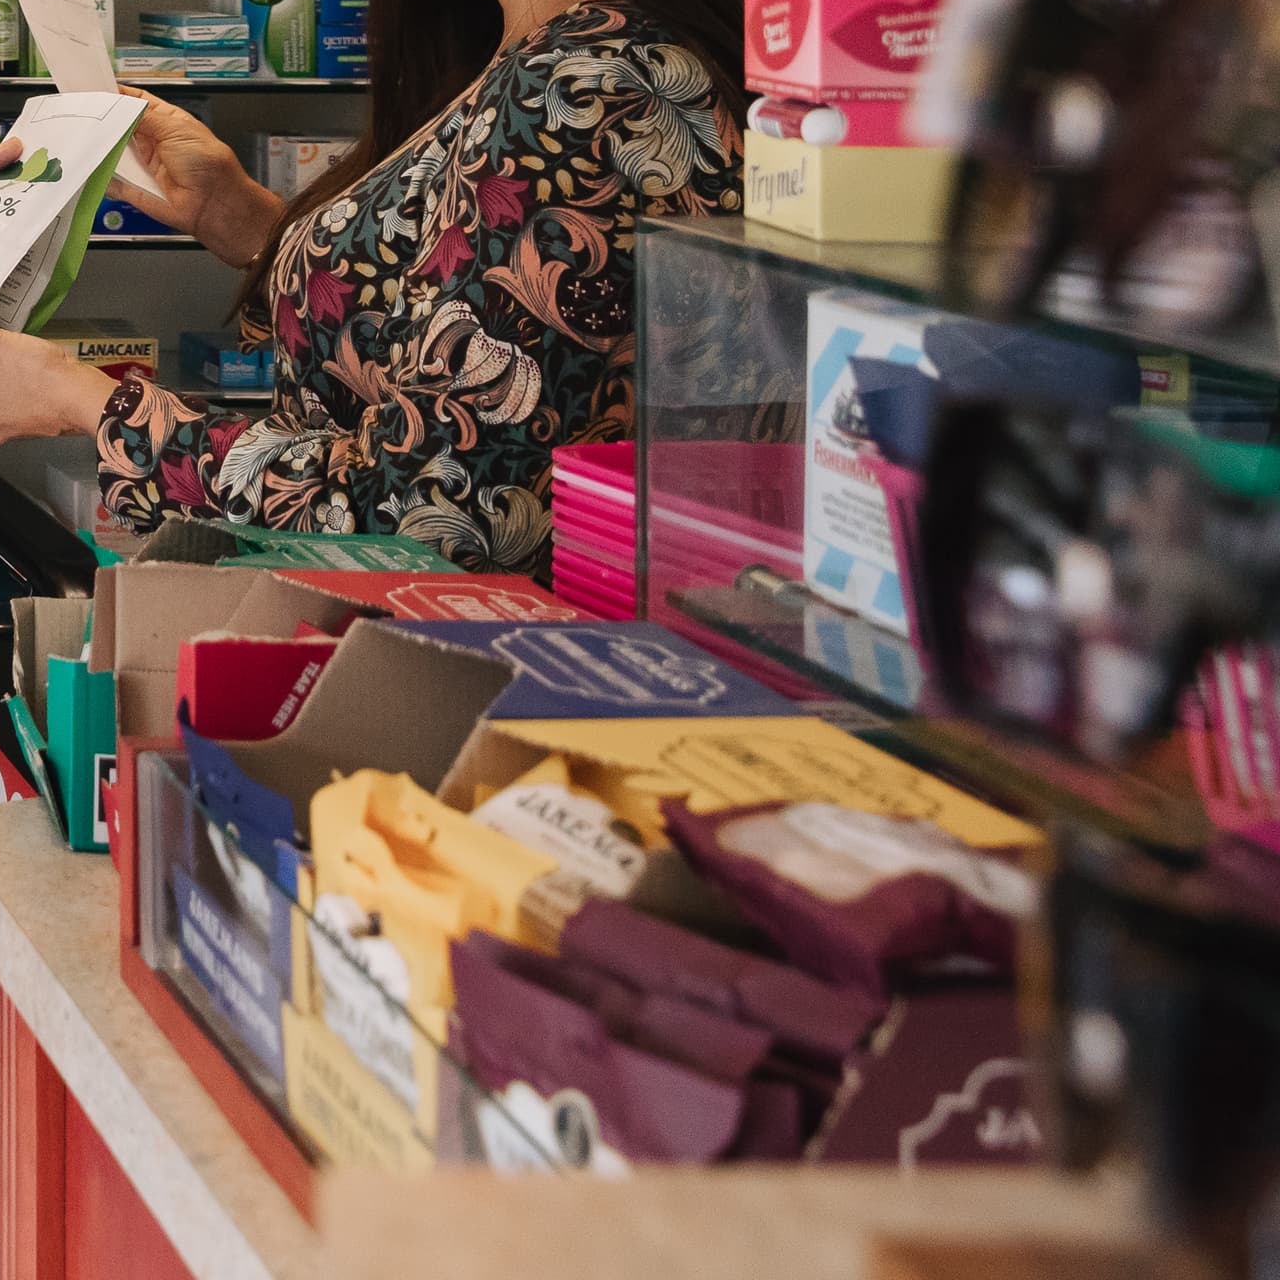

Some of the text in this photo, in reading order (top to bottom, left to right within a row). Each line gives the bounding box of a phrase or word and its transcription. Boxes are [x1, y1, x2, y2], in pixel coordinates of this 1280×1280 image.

[750, 156, 806, 204] Try me!
[78, 341, 152, 358] LANACANE
[272, 661, 320, 728] TEAR HERE
